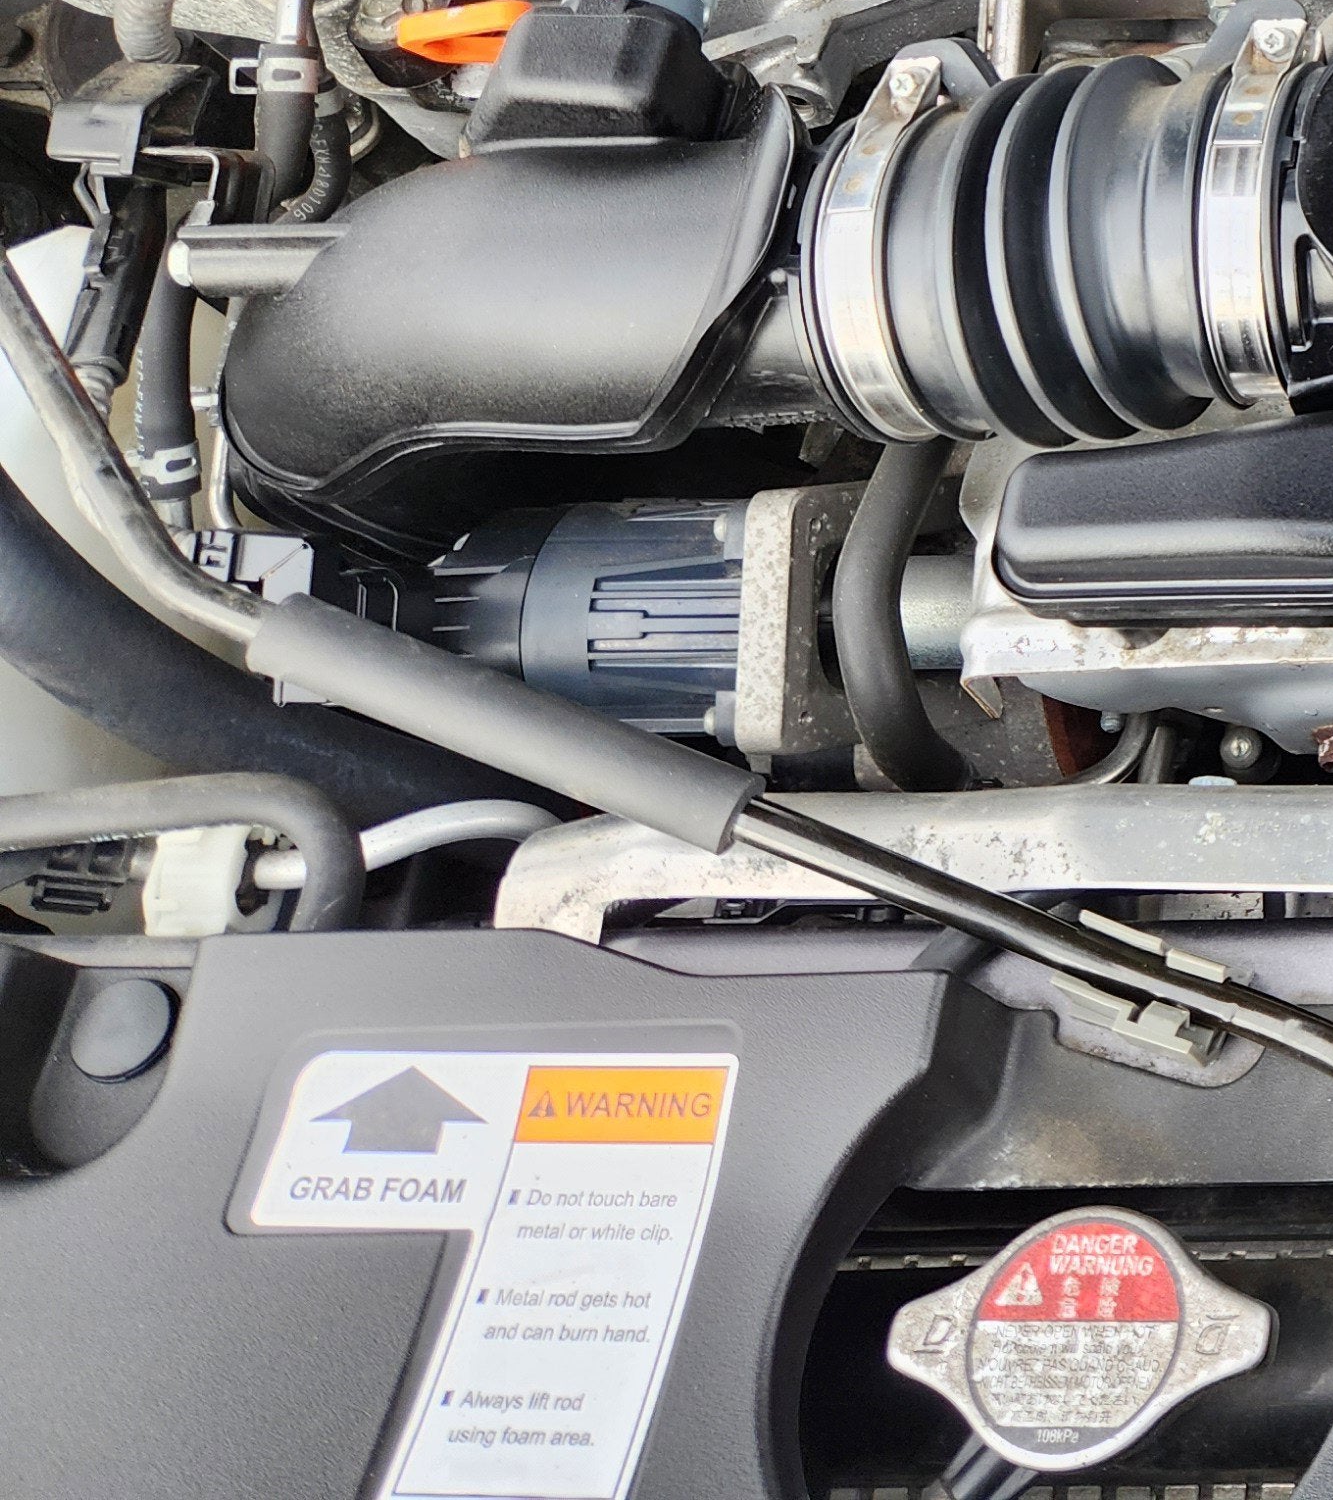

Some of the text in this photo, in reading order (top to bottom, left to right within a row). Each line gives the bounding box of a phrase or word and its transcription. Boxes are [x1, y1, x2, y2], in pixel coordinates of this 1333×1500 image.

[567, 1091, 713, 1118] WARNING
[289, 1175, 467, 1204] GRAB FOAM
[526, 1188, 678, 1208] Do not touch bare
[516, 1222, 673, 1246] metal or white clip.
[1051, 1233, 1138, 1254] DANGER
[1050, 1255, 1154, 1276] WARNUNG
[495, 1289, 652, 1311] Metal rod gets hot
[484, 1323, 651, 1343] and can burn hand.
[459, 1390, 585, 1413] Always lift rod
[448, 1427, 595, 1449] using foam area.
[1036, 1428, 1080, 1444] 108kPa
